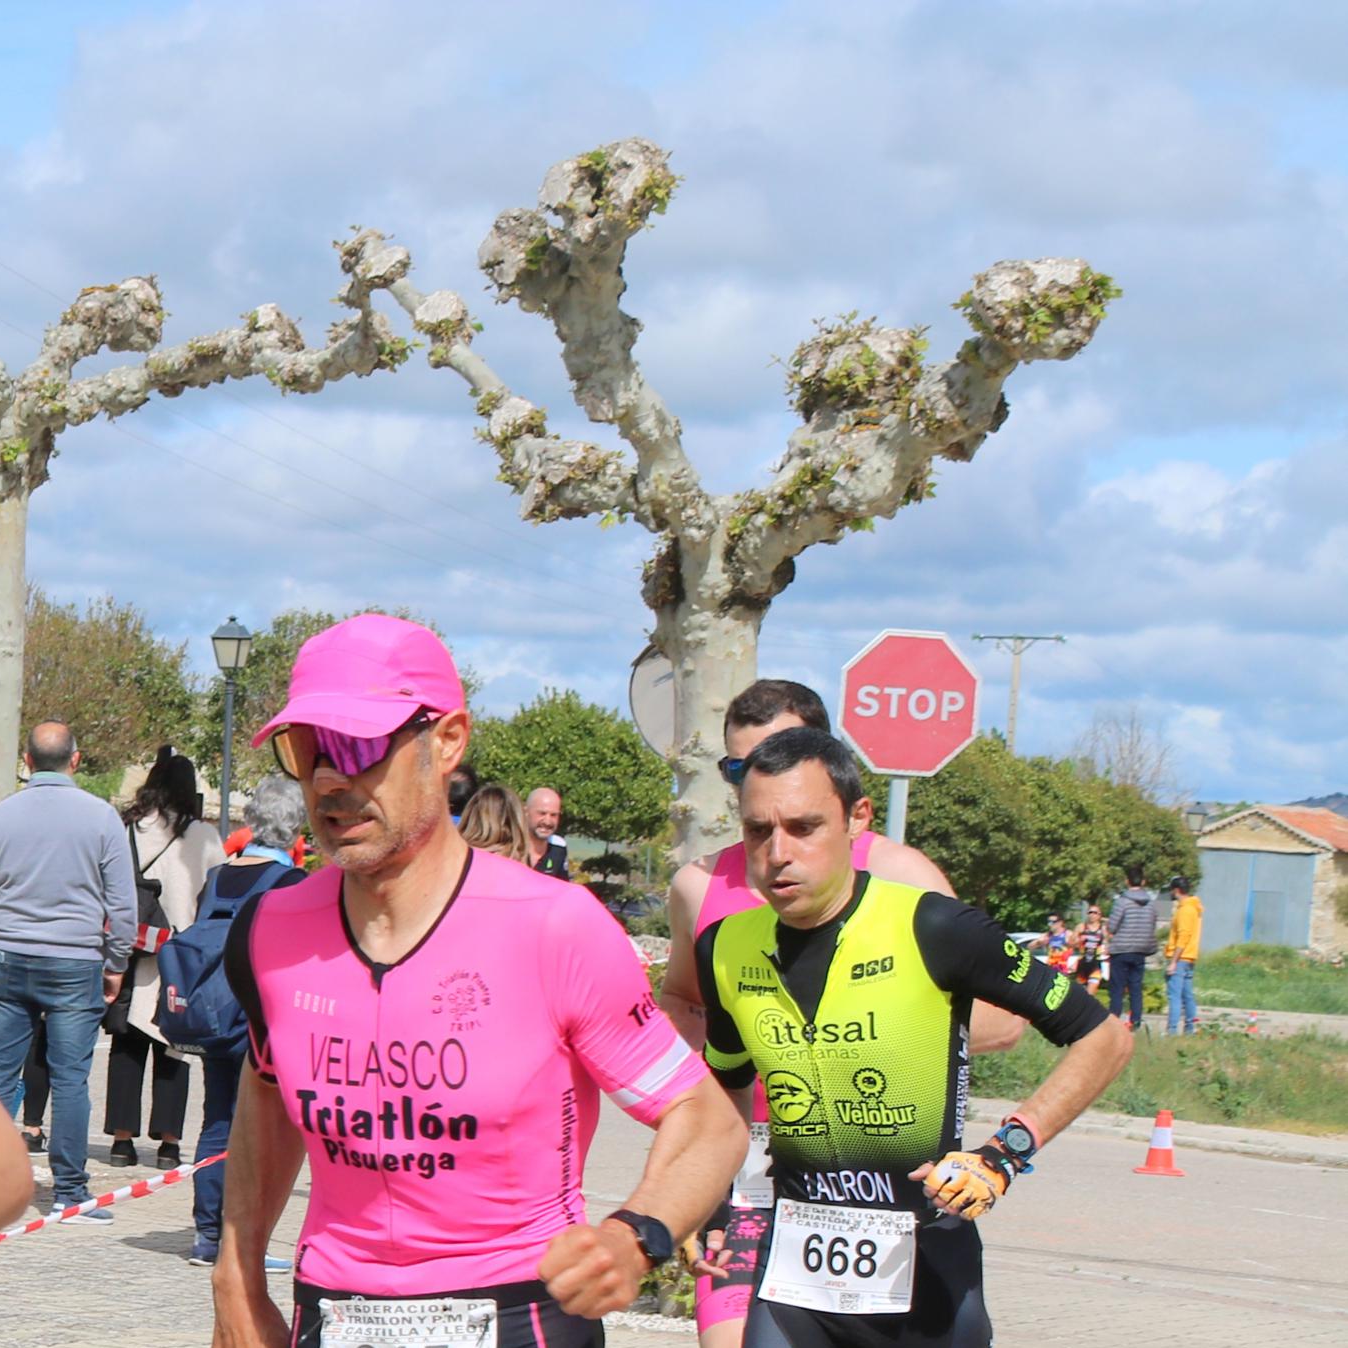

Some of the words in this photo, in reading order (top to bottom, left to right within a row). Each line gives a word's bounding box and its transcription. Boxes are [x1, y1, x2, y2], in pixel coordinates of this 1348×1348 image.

[854, 685, 966, 721] STOP
[293, 990, 337, 1017] GOBIK
[310, 1032, 468, 1091] VELASCO
[296, 1089, 478, 1142] Triatlón
[836, 1101, 917, 1127] Velobur
[322, 1138, 456, 1180] Pisuerga
[802, 1233, 878, 1279] 668
[345, 1326, 420, 1337] CASTILLA
[426, 1326, 436, 1335] Y
[347, 1315, 413, 1326] TRIATLON
[417, 1315, 426, 1324] Y
